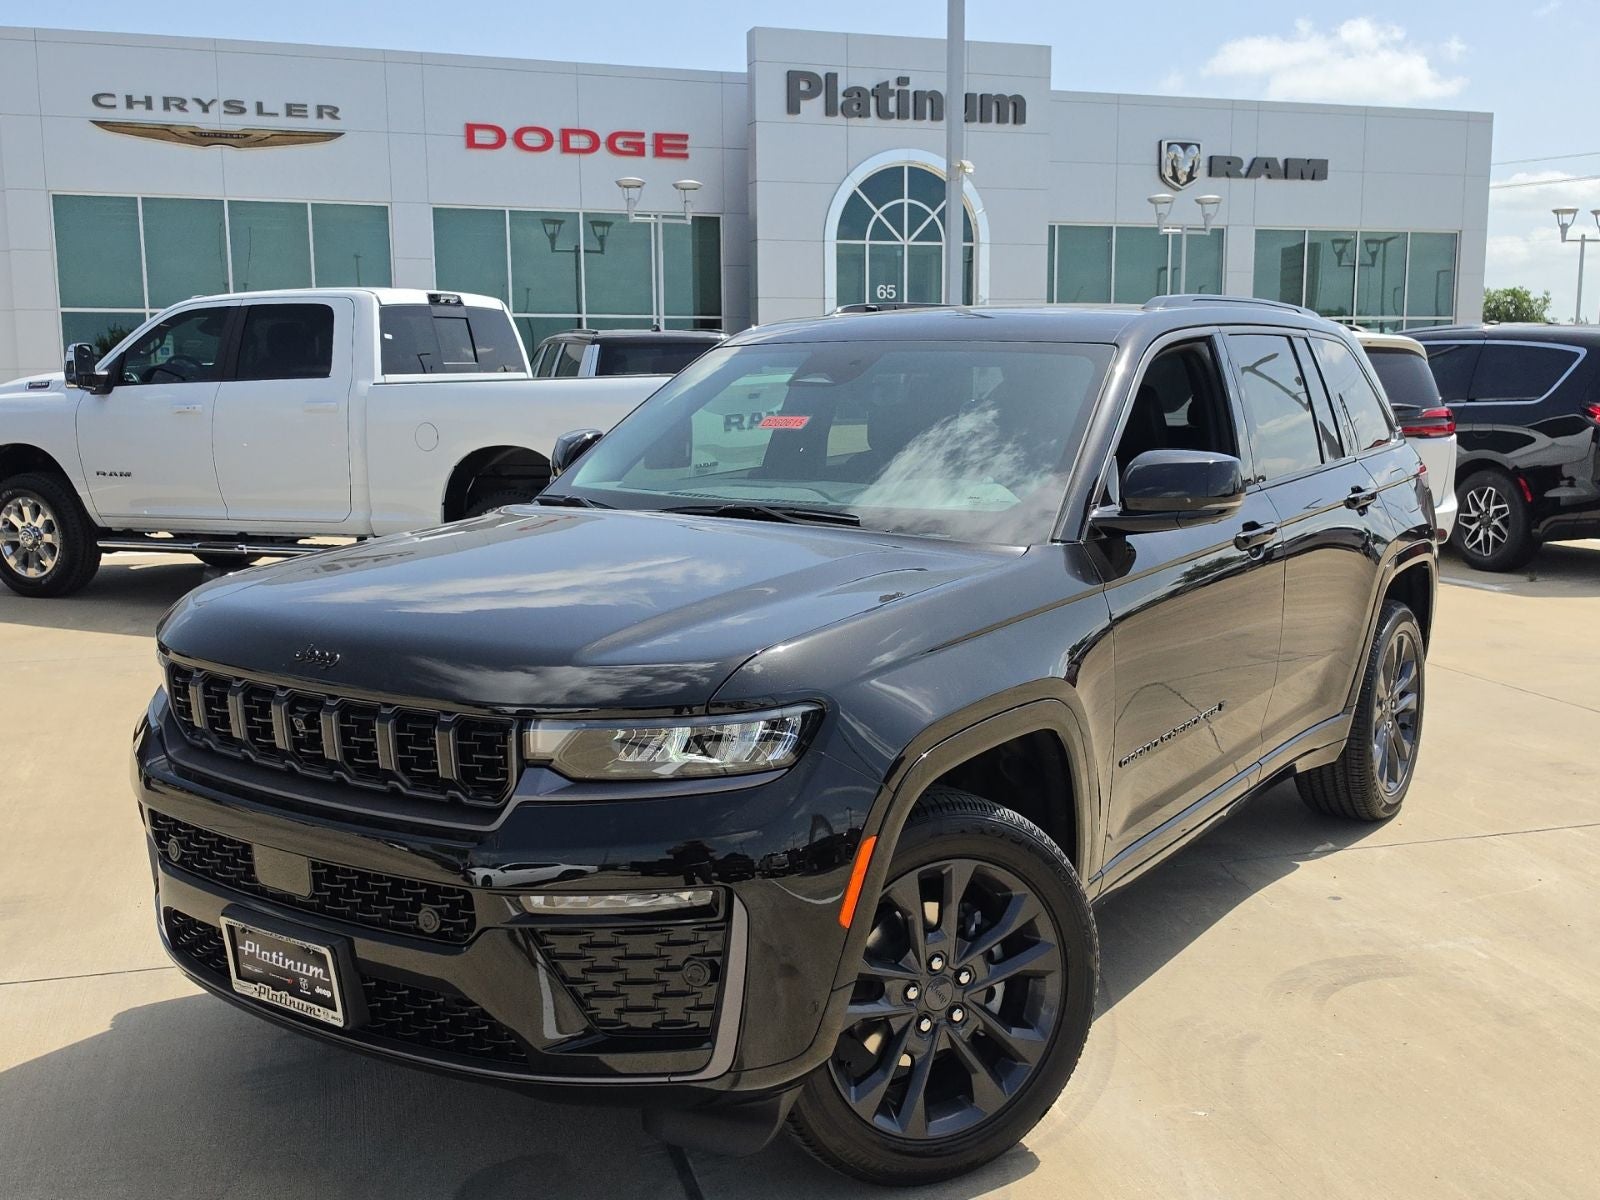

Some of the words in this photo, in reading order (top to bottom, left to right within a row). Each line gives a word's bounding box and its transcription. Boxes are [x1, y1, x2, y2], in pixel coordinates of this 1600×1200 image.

[91, 92, 342, 120] CHRYSLER
[464, 122, 690, 159] DODGE
[1208, 155, 1329, 181] RAM
[876, 284, 897, 299] 65
[96, 470, 132, 478] RAM
[238, 940, 331, 982] Platinum
